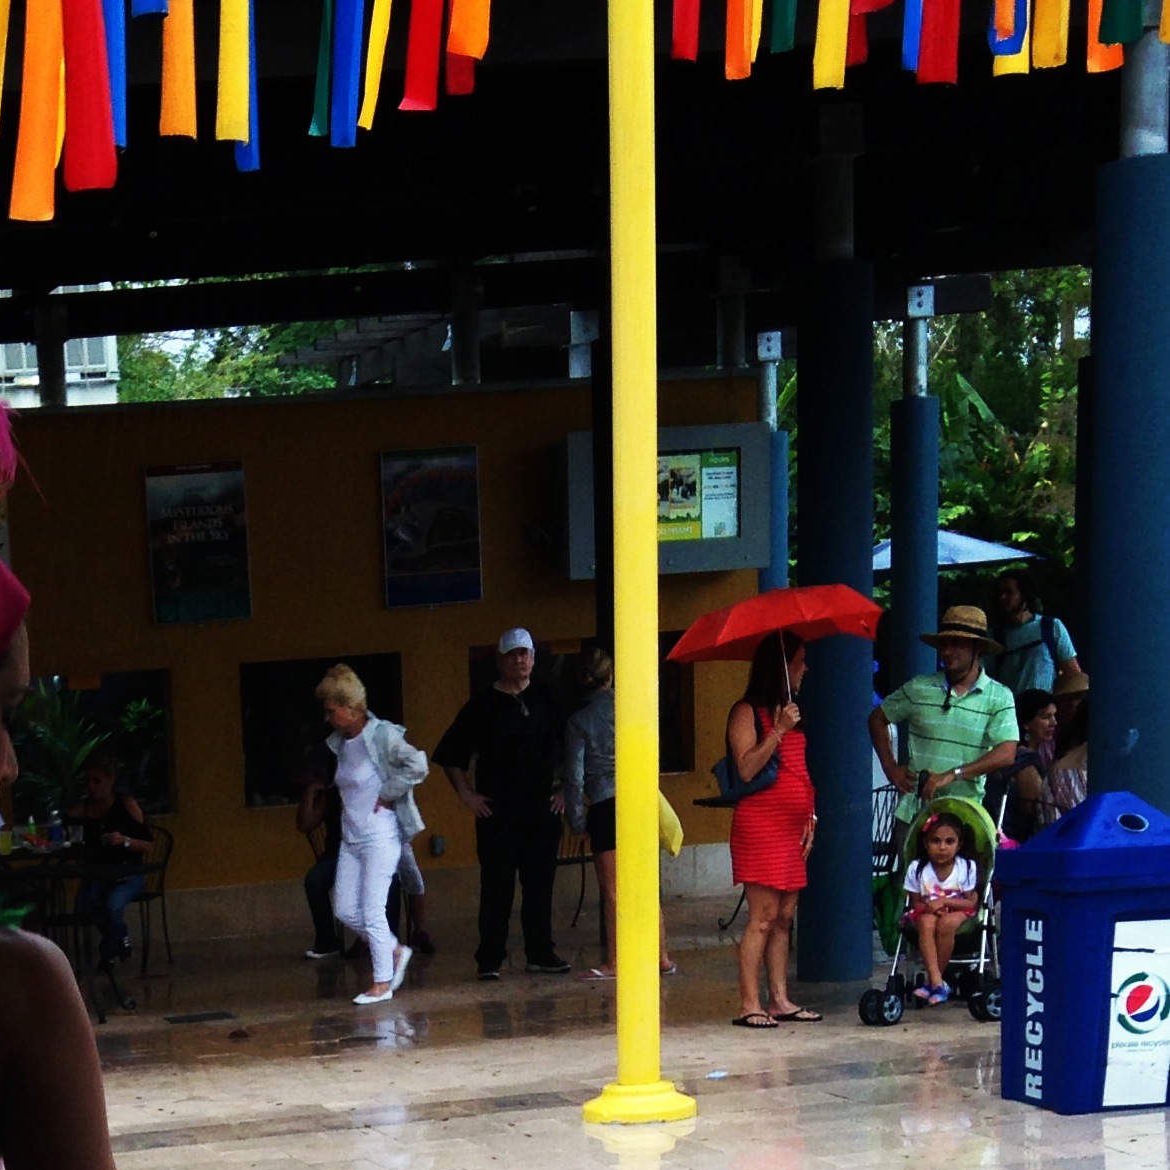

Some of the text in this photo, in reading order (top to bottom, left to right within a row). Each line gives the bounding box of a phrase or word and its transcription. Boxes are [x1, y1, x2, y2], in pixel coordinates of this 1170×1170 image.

[172, 518, 223, 531] ISLANDS
[184, 532, 206, 543] THE
[1025, 918, 1044, 1100] RECYCLE
